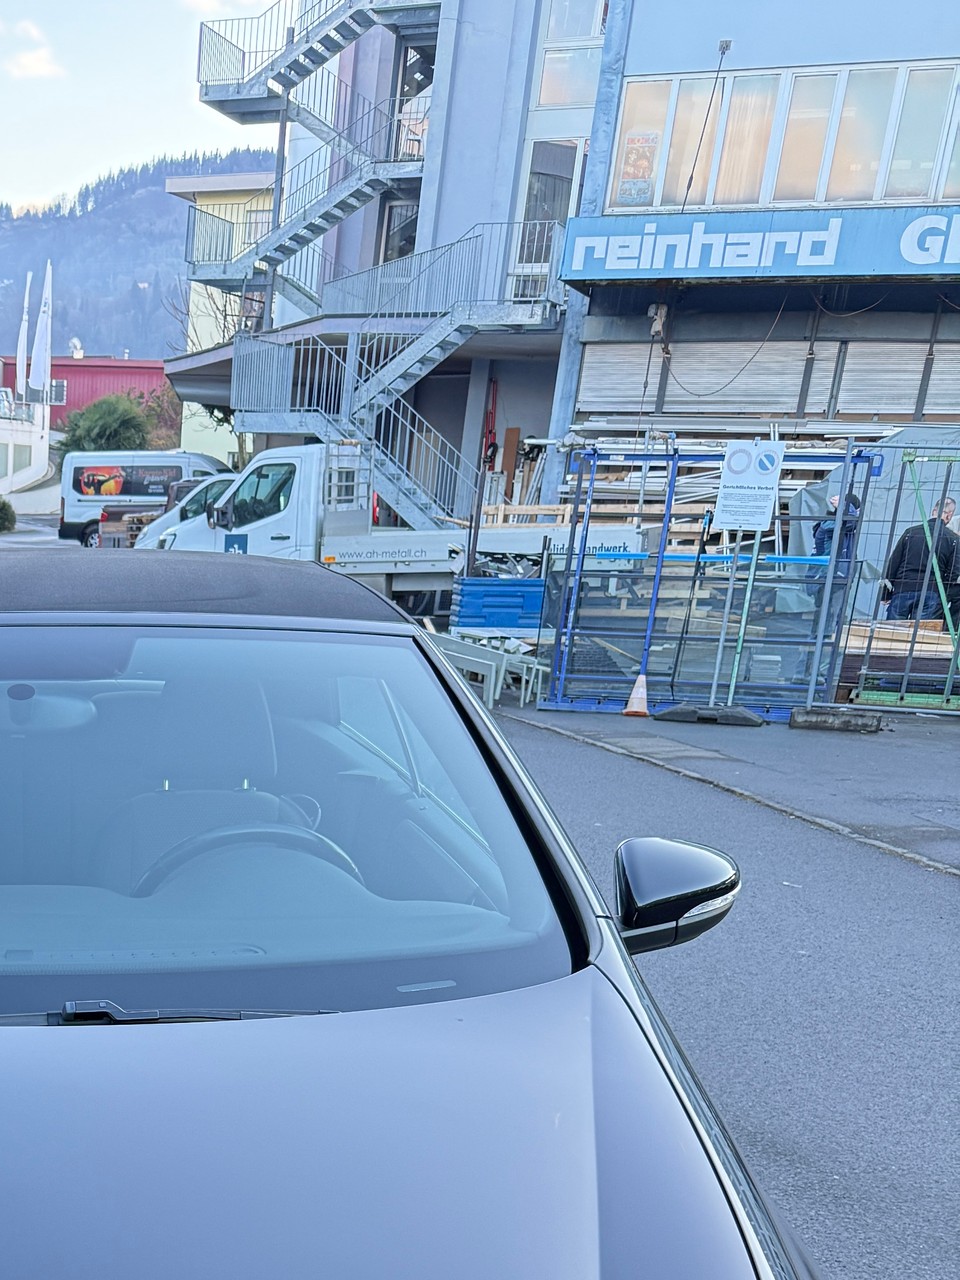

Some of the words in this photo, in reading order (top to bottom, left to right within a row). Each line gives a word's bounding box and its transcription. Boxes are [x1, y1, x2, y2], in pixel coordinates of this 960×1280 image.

[571, 217, 842, 271] reinhard
[586, 541, 631, 553] andwerk.
[339, 549, 427, 559] www.ah-metall.ch
